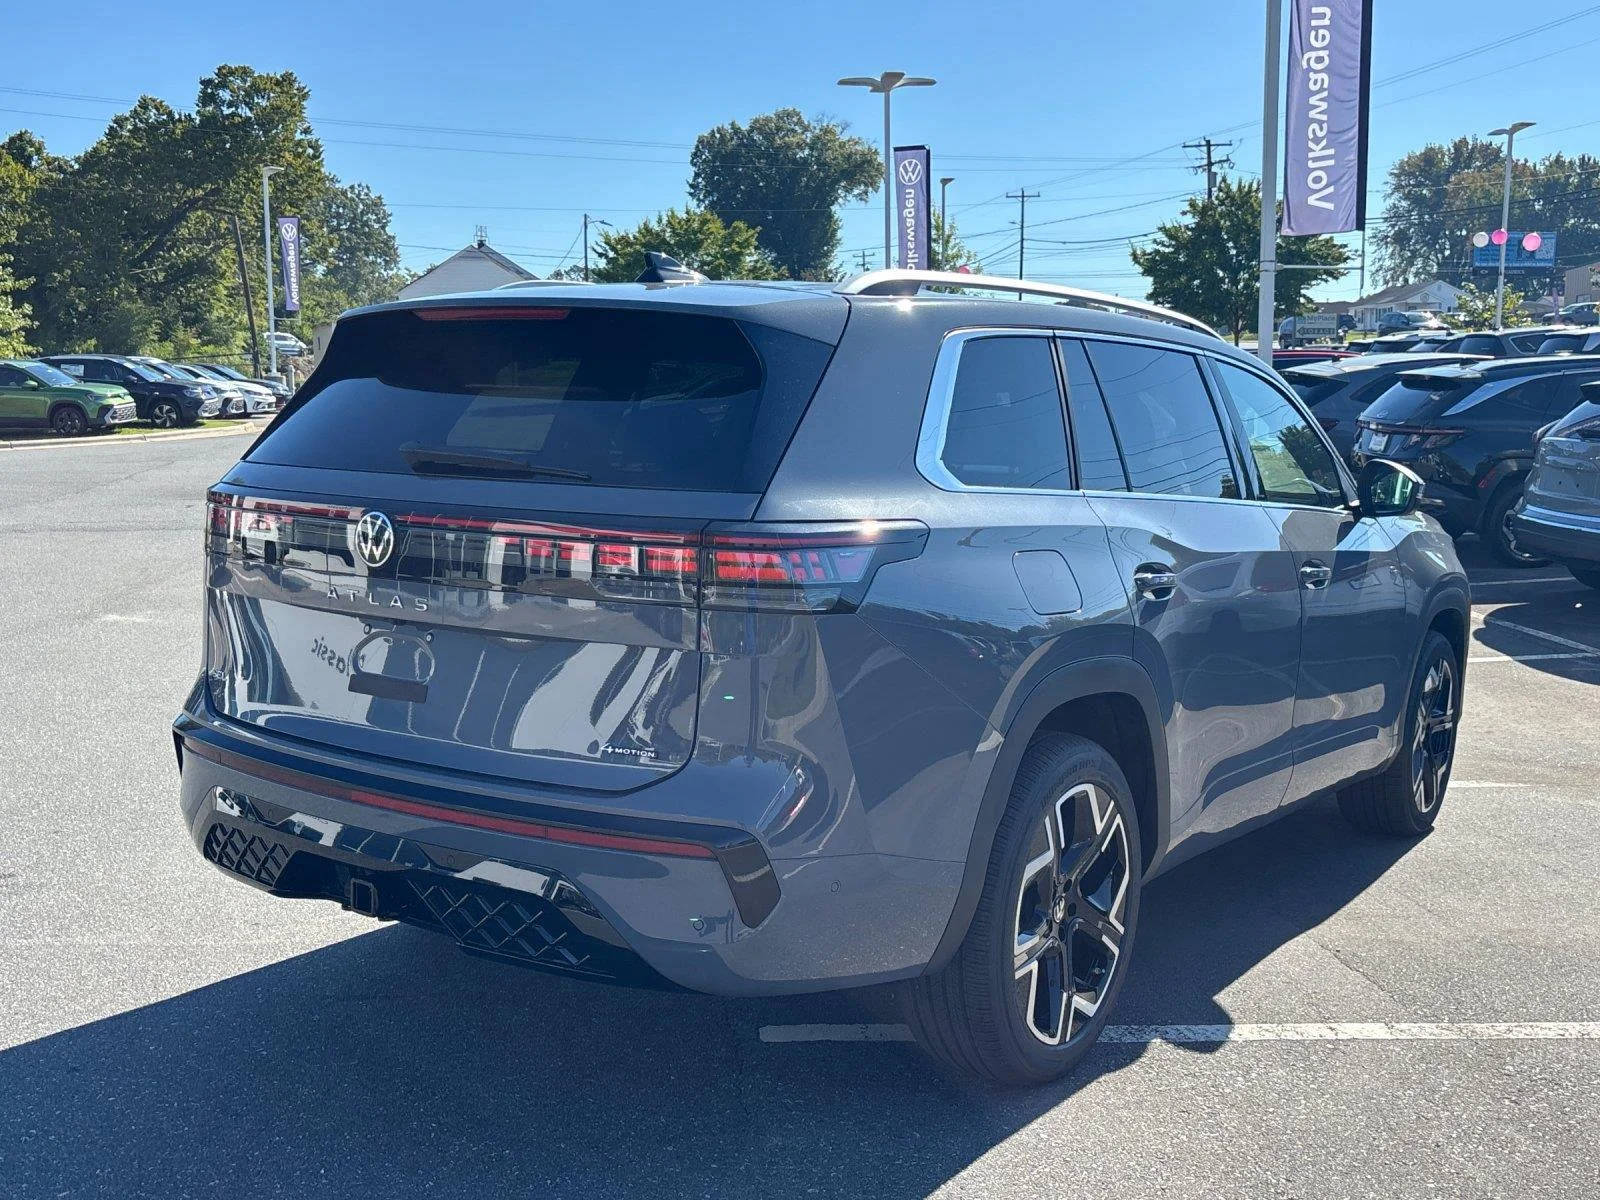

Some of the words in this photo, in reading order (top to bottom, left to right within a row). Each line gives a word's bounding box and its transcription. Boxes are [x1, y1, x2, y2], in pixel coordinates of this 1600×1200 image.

[355, 510, 394, 567] VW
[327, 586, 428, 612] ATLAS
[600, 743, 655, 758] 4MOTION
